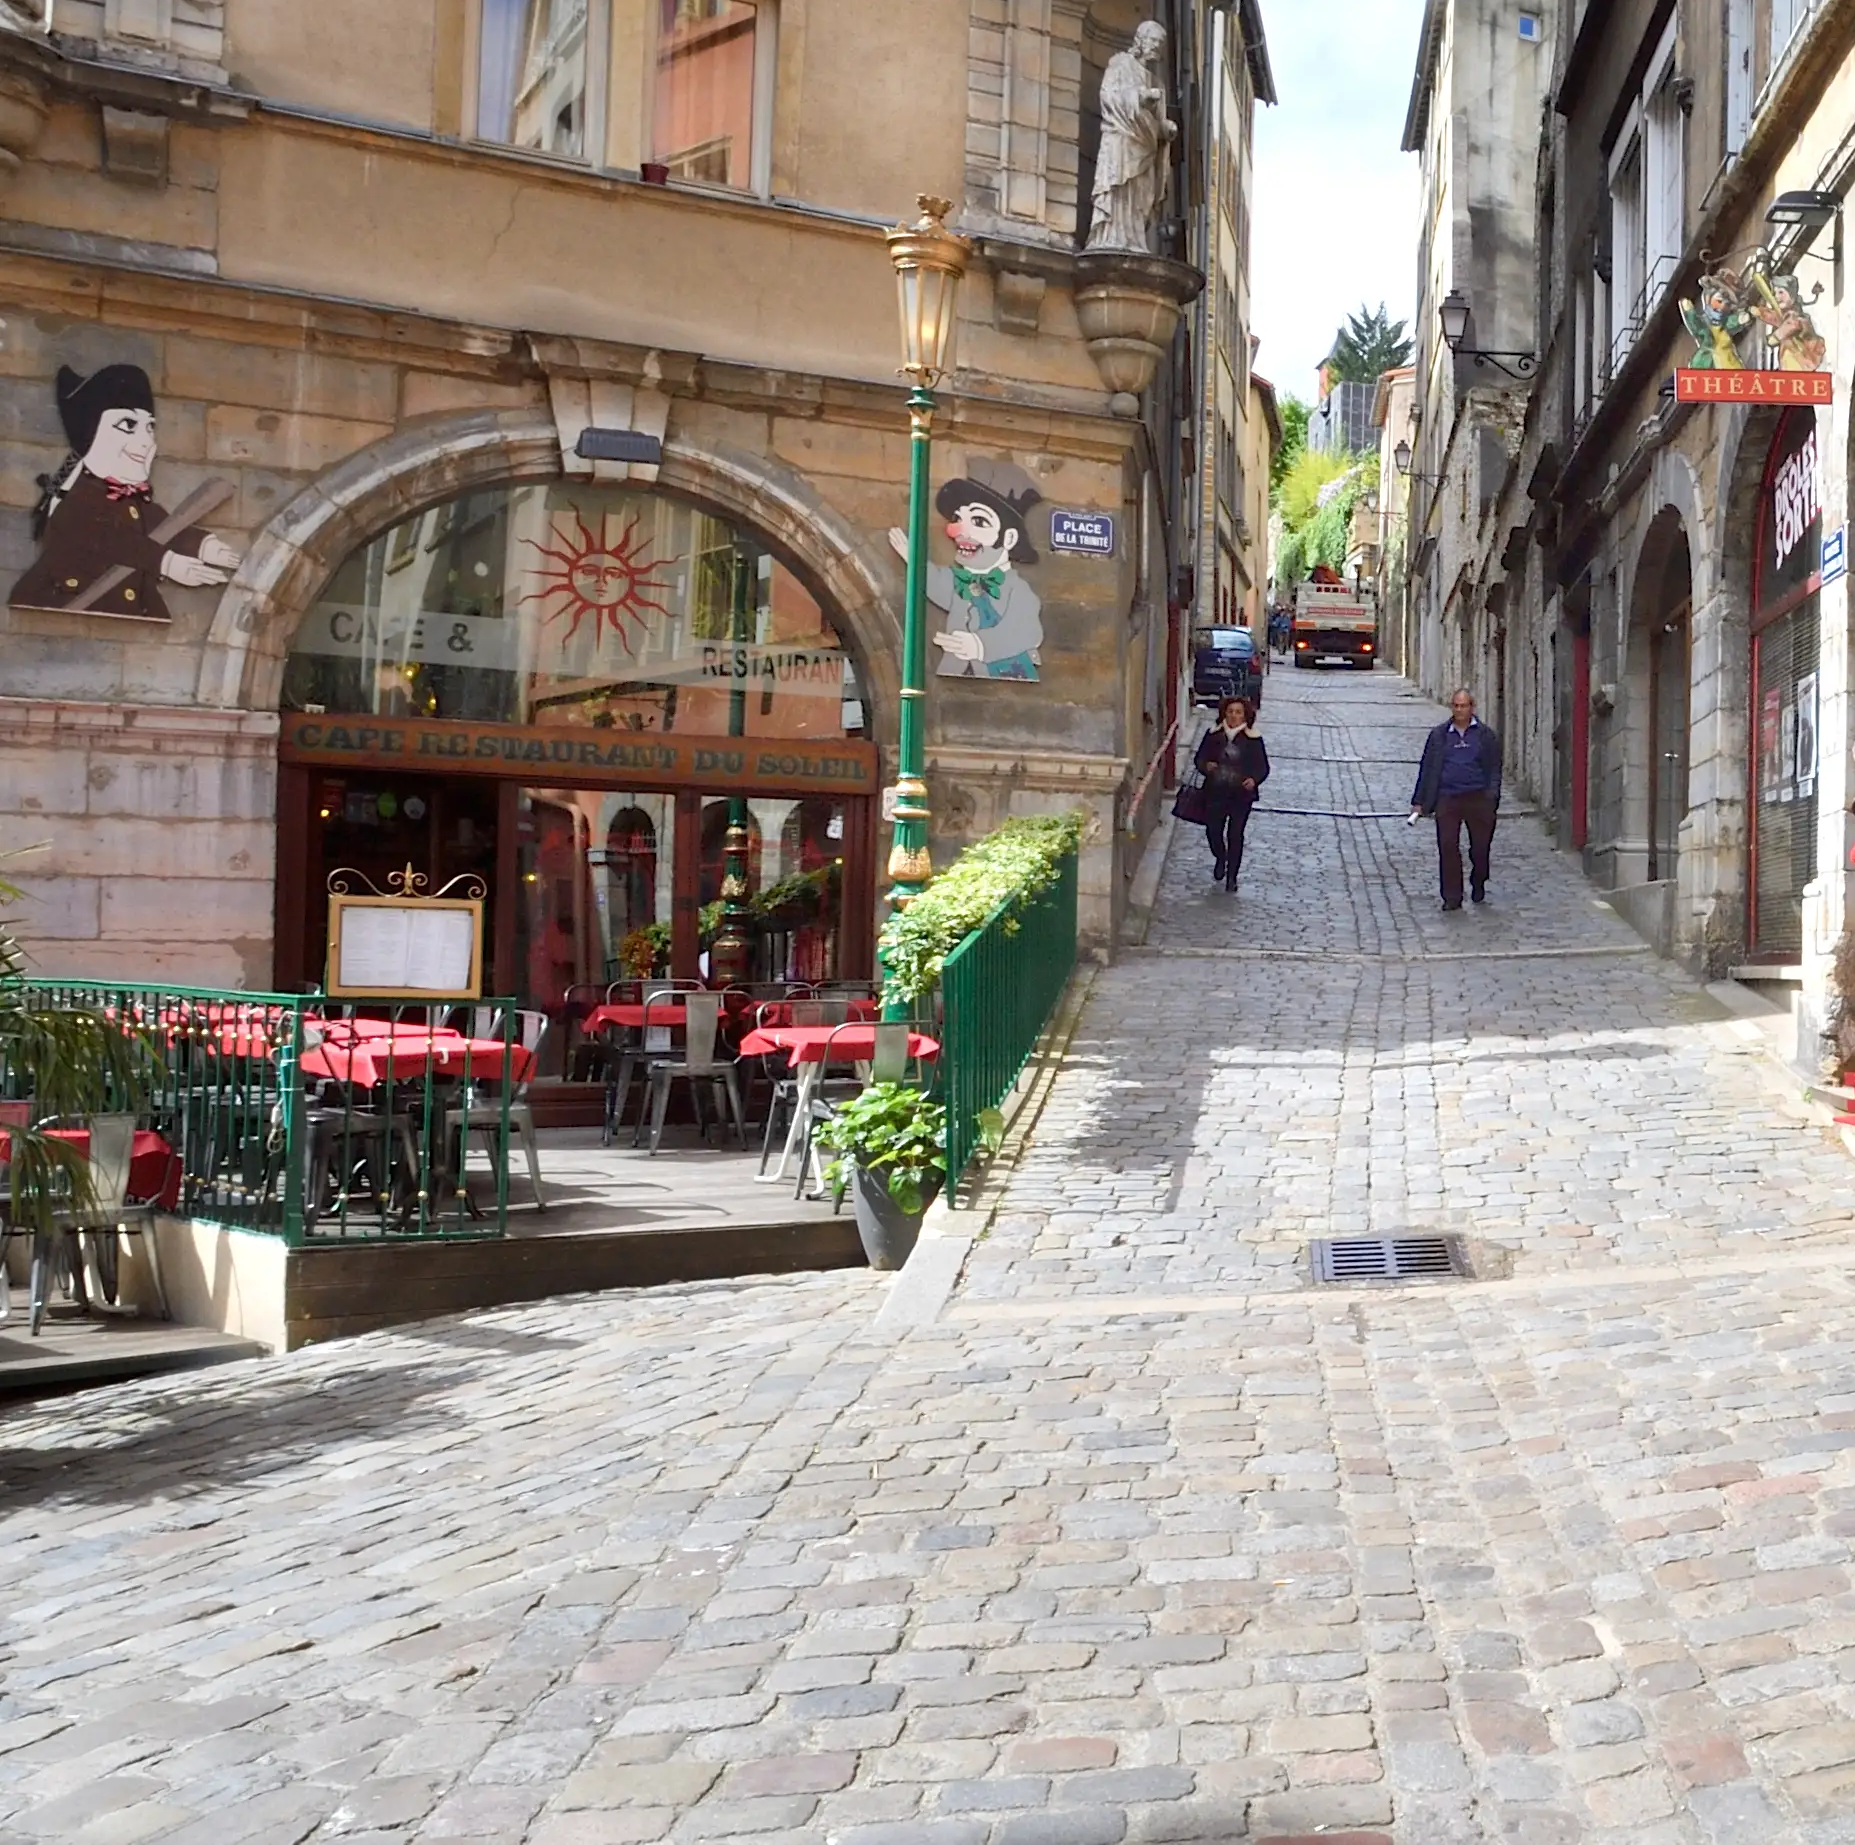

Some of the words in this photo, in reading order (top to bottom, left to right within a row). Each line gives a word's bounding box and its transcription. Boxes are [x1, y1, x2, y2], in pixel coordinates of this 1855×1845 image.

[1681, 373, 1828, 397] THÉÂTRE
[1055, 532, 1065, 543] DE
[1066, 533, 1077, 545] LA
[1063, 520, 1102, 535] PLACE
[447, 622, 474, 652] &
[702, 646, 854, 685] RESTAURAN
[418, 732, 676, 769] RESTAURANT
[693, 749, 745, 774] DU
[756, 753, 868, 780] SOLEIL
